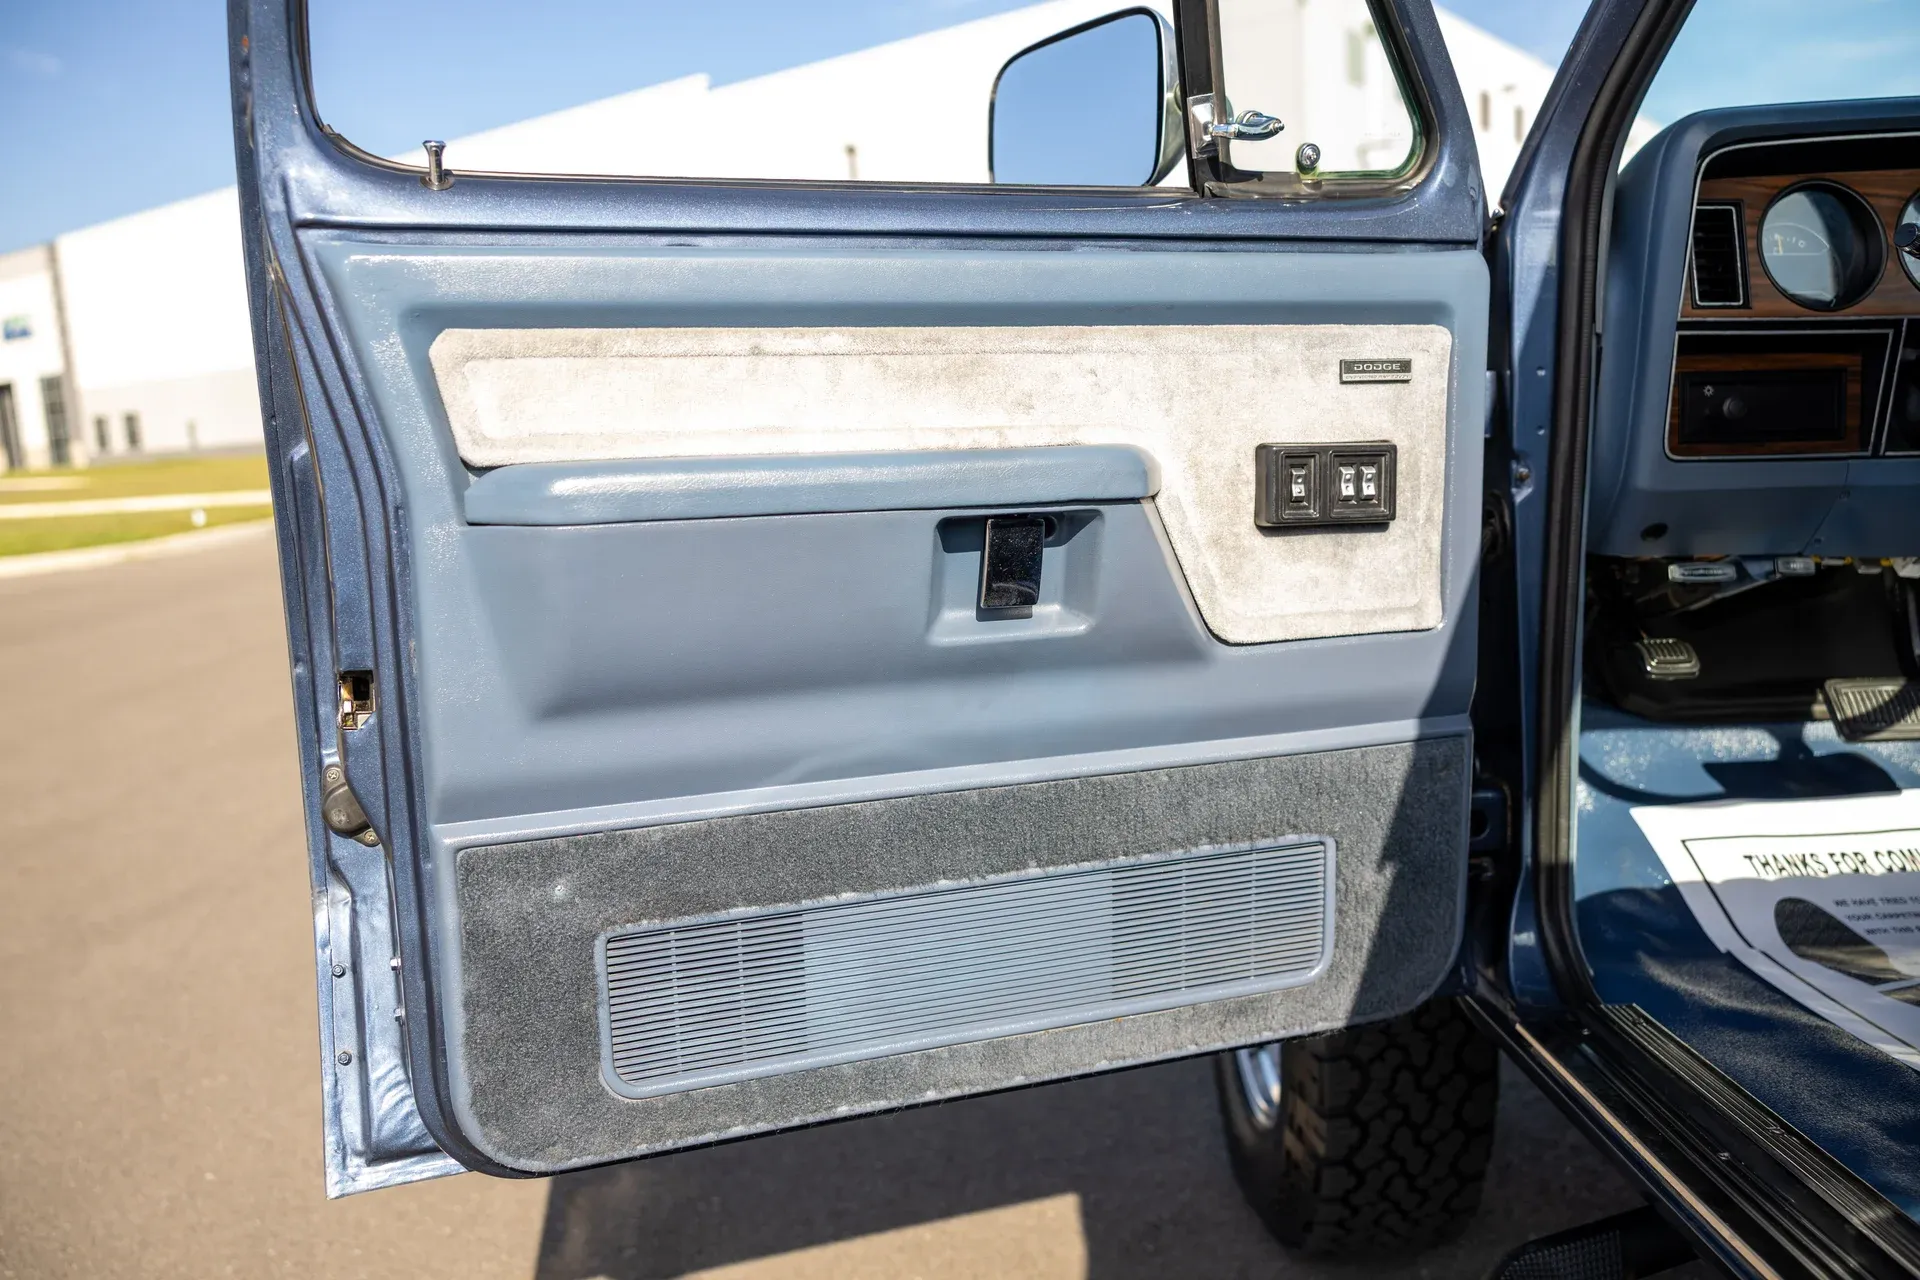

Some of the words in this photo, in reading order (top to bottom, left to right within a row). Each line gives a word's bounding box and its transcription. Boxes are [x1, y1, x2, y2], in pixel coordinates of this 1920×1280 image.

[1354, 363, 1401, 371] DODGE
[1743, 853, 1828, 877] THANKS
[1828, 852, 1876, 875] FOR
